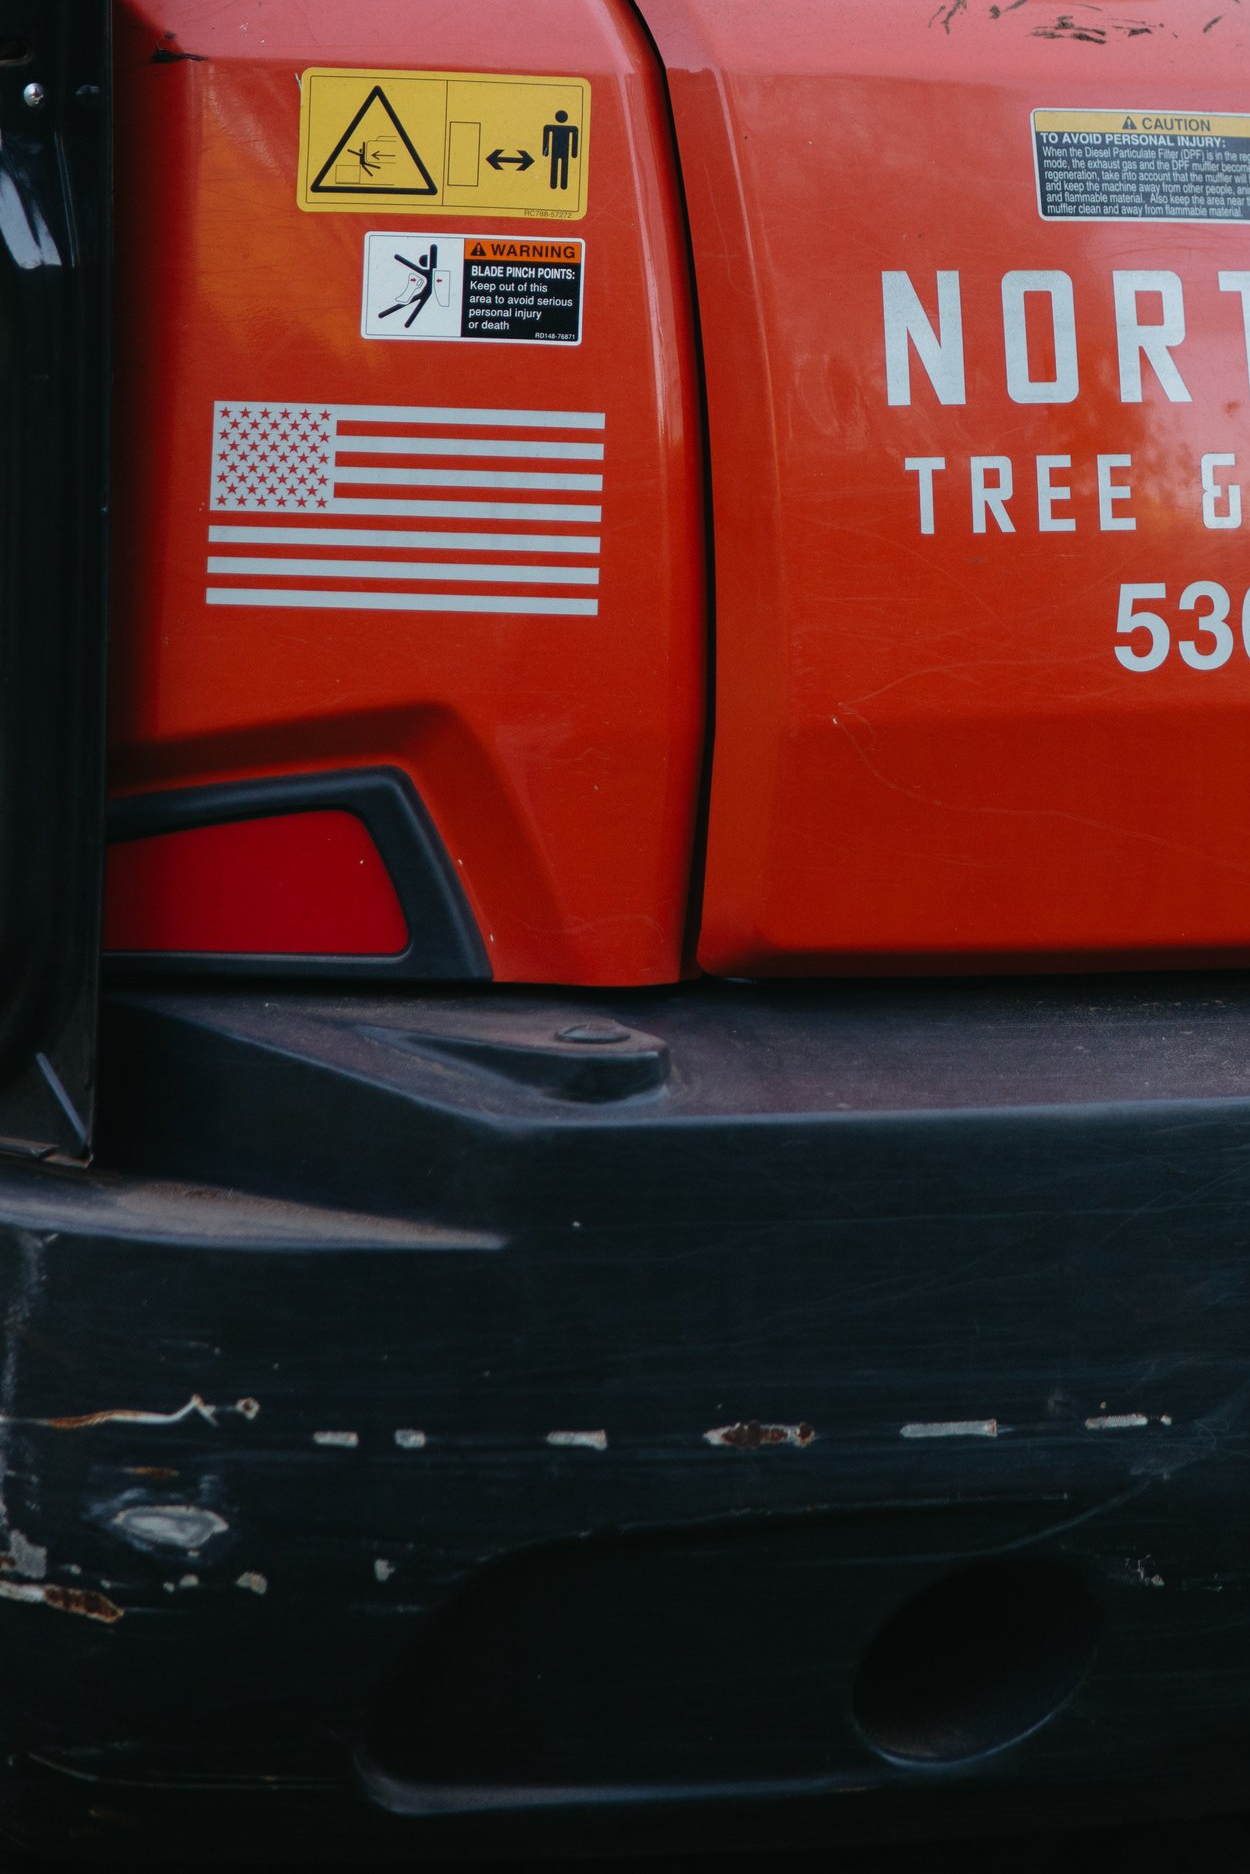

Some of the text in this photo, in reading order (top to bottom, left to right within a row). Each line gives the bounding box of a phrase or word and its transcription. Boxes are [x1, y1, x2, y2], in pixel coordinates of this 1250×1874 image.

[1142, 117, 1211, 131] CAUTION
[1040, 133, 1226, 148] TO AVOID PERSONAL INJURY:
[1042, 146, 1067, 157] When
[1070, 147, 1082, 157] the
[1085, 147, 1111, 158] Diesel
[1113, 148, 1156, 158] Particulate
[1158, 148, 1178, 159] Filter
[1180, 149, 1204, 160] (DPF)
[1207, 151, 1213, 160] is
[1215, 151, 1223, 160] in
[1225, 151, 1237, 161] the
[1043, 159, 1070, 169] mode,
[1072, 160, 1086, 168] the
[1088, 160, 1120, 169] exhaust
[1122, 161, 1137, 171] gas
[1139, 160, 1155, 170] and
[1157, 161, 1170, 170] the
[1172, 160, 1189, 170] DPF
[1192, 162, 1219, 171] muffler
[1045, 170, 1099, 181] regeneration,
[1102, 170, 1119, 180] take
[1121, 171, 1136, 180] into
[1139, 172, 1171, 181] account
[1173, 172, 1189, 182] that
[1190, 173, 1203, 182] the
[1205, 173, 1232, 183] muffler
[1234, 175, 1247, 184] will
[1046, 181, 1061, 191] and
[1064, 181, 1084, 193] keep
[1087, 182, 1099, 191] the
[1102, 182, 1136, 192] machine
[1139, 184, 1160, 195] away
[1162, 183, 1180, 193] from
[1183, 184, 1203, 193] other
[1206, 185, 1235, 196] people,
[1047, 192, 1062, 202] and
[1065, 192, 1107, 203] flammable
[1110, 193, 1145, 203] material.
[1150, 194, 1168, 203] Also
[1171, 195, 1190, 206] keep
[1192, 195, 1205, 205] the
[1207, 197, 1224, 205] area
[1227, 197, 1244, 206] near
[1048, 204, 1243, 217] muffler clean and away from flammable material.
[491, 244, 575, 258] WARNING
[471, 266, 575, 279] BLADE PINCH POINTS:
[470, 281, 548, 292] Keep out of this
[508, 295, 534, 305] avoid
[537, 297, 572, 306] serious
[469, 308, 541, 320] personal injury
[482, 321, 509, 330] death
[904, 453, 1139, 534] TREE
[1200, 452, 1242, 530] &
